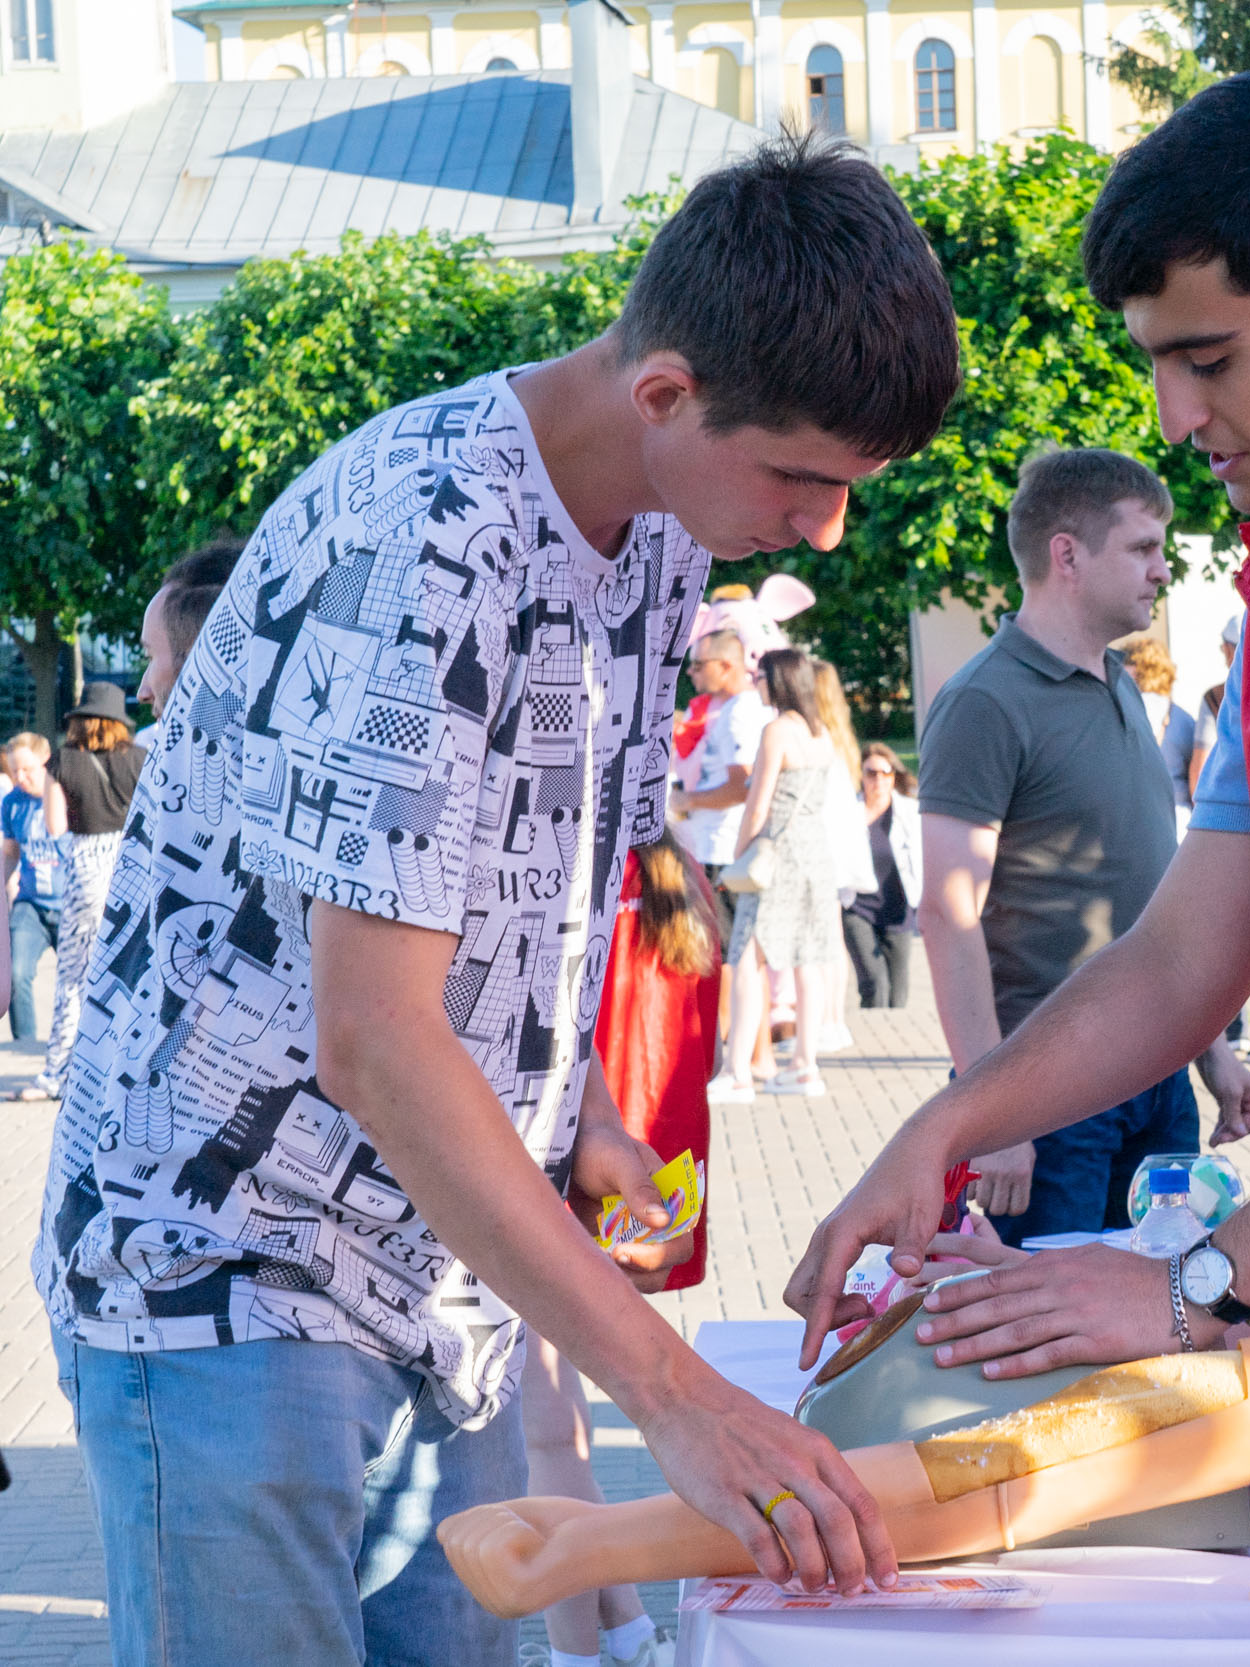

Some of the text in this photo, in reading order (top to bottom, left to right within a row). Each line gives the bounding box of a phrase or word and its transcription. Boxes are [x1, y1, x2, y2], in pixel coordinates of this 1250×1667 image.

[198, 1053, 219, 1069] time
[222, 1067, 246, 1082] over
[207, 1040, 227, 1056] time
[231, 1054, 254, 1069] over
[257, 1065, 279, 1081] time
[214, 1080, 238, 1095] over
[178, 1091, 200, 1105] time
[198, 1115, 224, 1127] over
